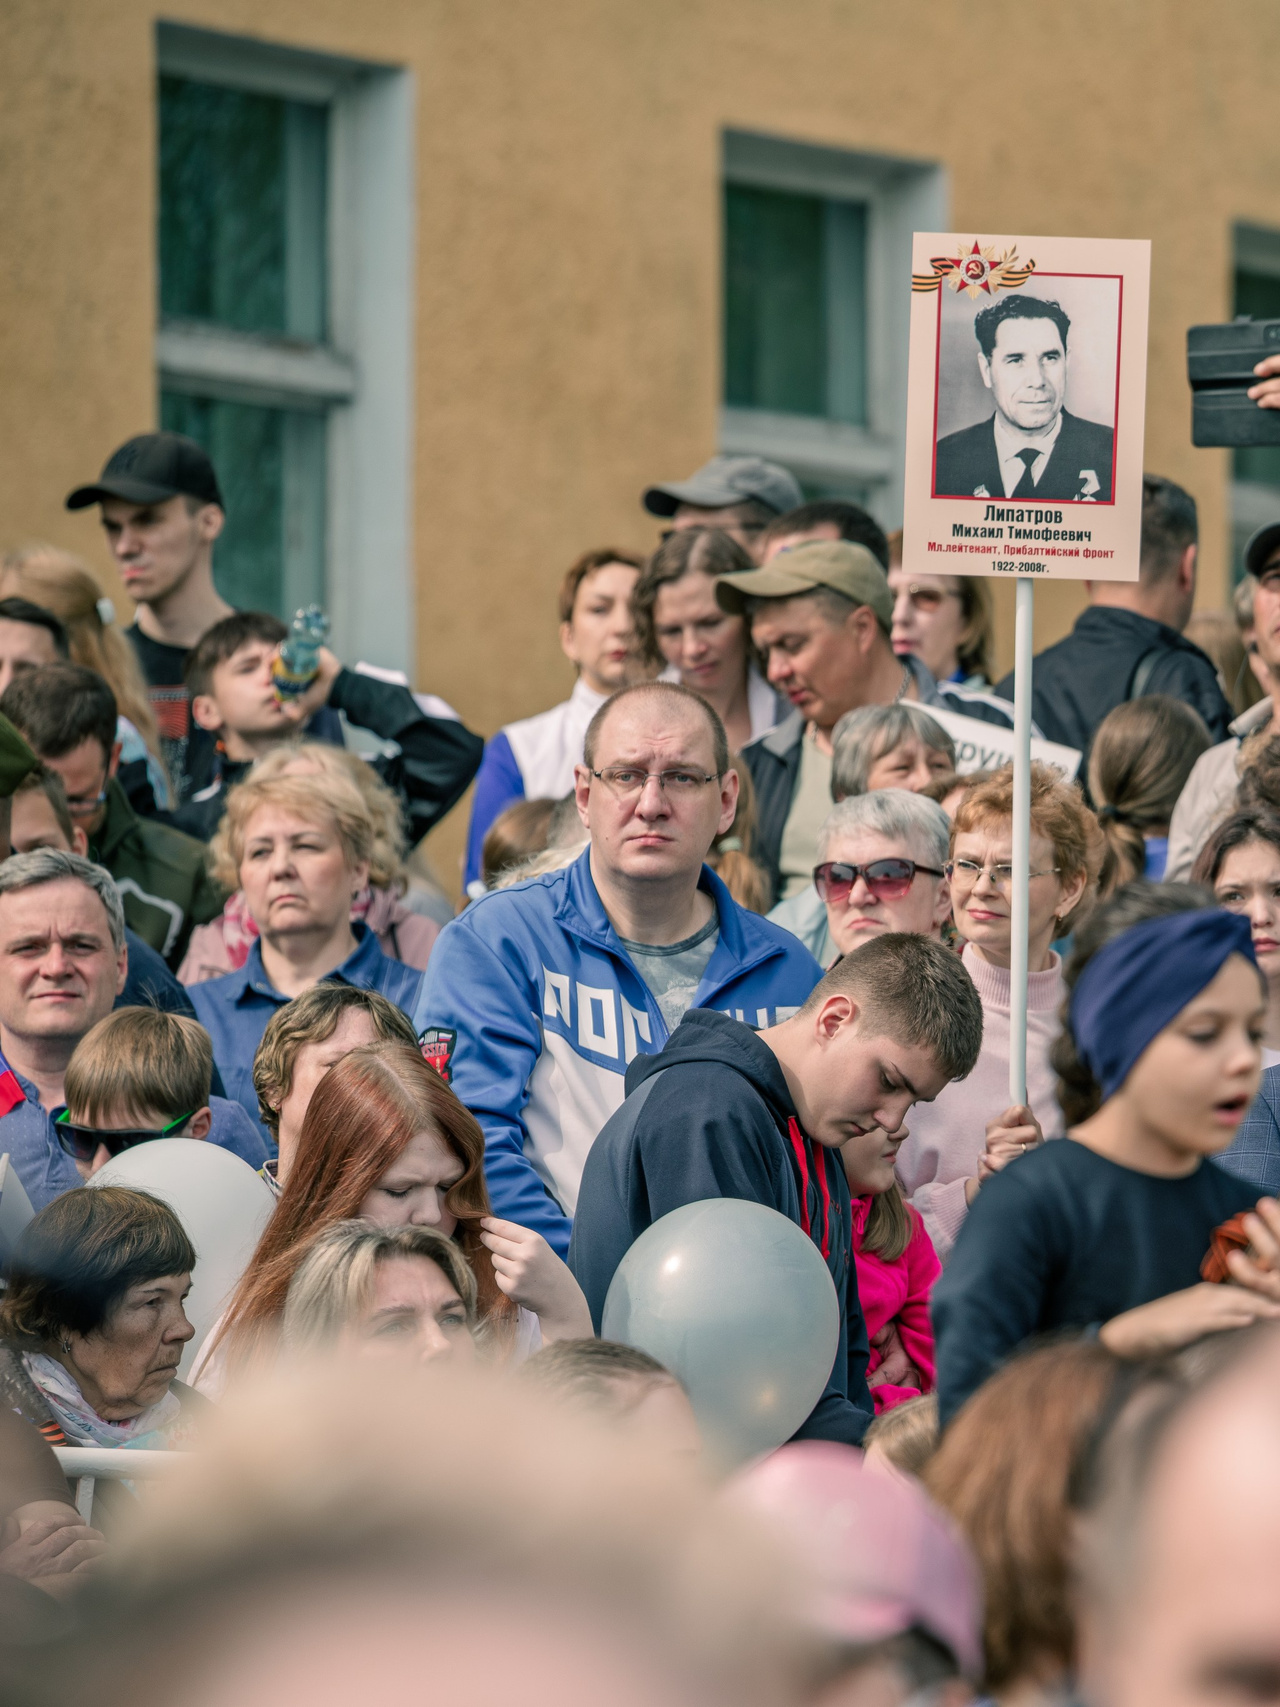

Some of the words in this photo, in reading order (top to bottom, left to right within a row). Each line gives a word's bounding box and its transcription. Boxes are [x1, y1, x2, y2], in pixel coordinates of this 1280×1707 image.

[984, 504, 1063, 525] Липатров
[951, 523, 1004, 539] Михаил
[1008, 525, 1092, 542] Тимофеевич
[927, 541, 1001, 556] Мл.лейтенант,
[1003, 544, 1080, 557] Прибалтийский
[1082, 547, 1115, 559] фронт
[991, 560, 1050, 573] 1922-2008г.
